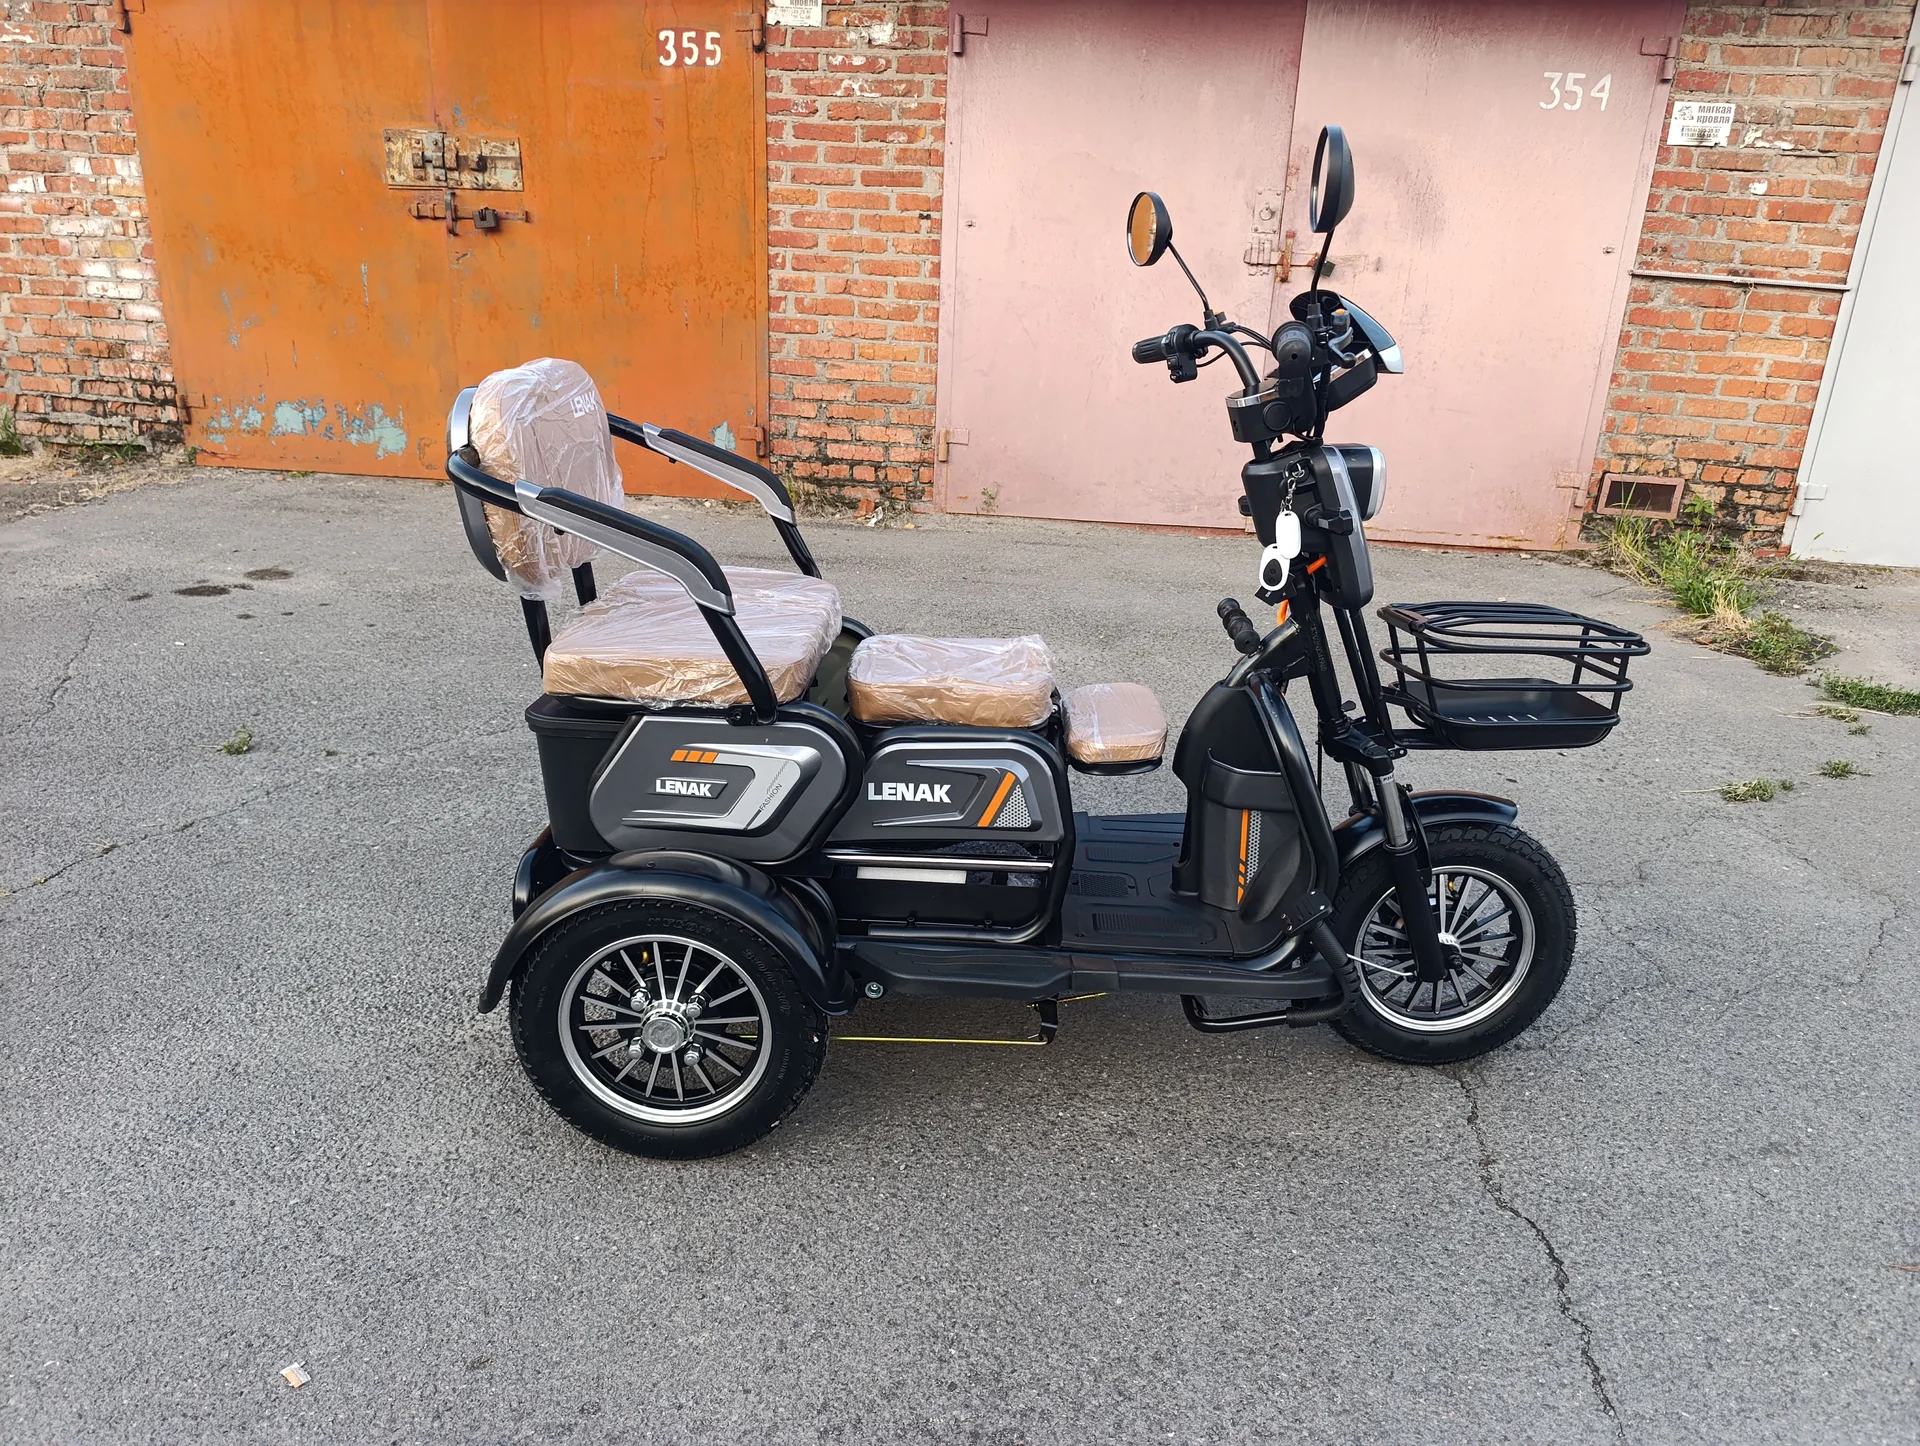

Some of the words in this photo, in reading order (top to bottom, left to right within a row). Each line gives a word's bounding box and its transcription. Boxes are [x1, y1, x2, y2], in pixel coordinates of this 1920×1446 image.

[658, 29, 722, 66] 355
[1539, 71, 1612, 111] 354
[570, 390, 598, 418] LENAK
[656, 779, 712, 797] LENAK
[760, 783, 783, 811] FASHION
[868, 782, 951, 803] LENAK
